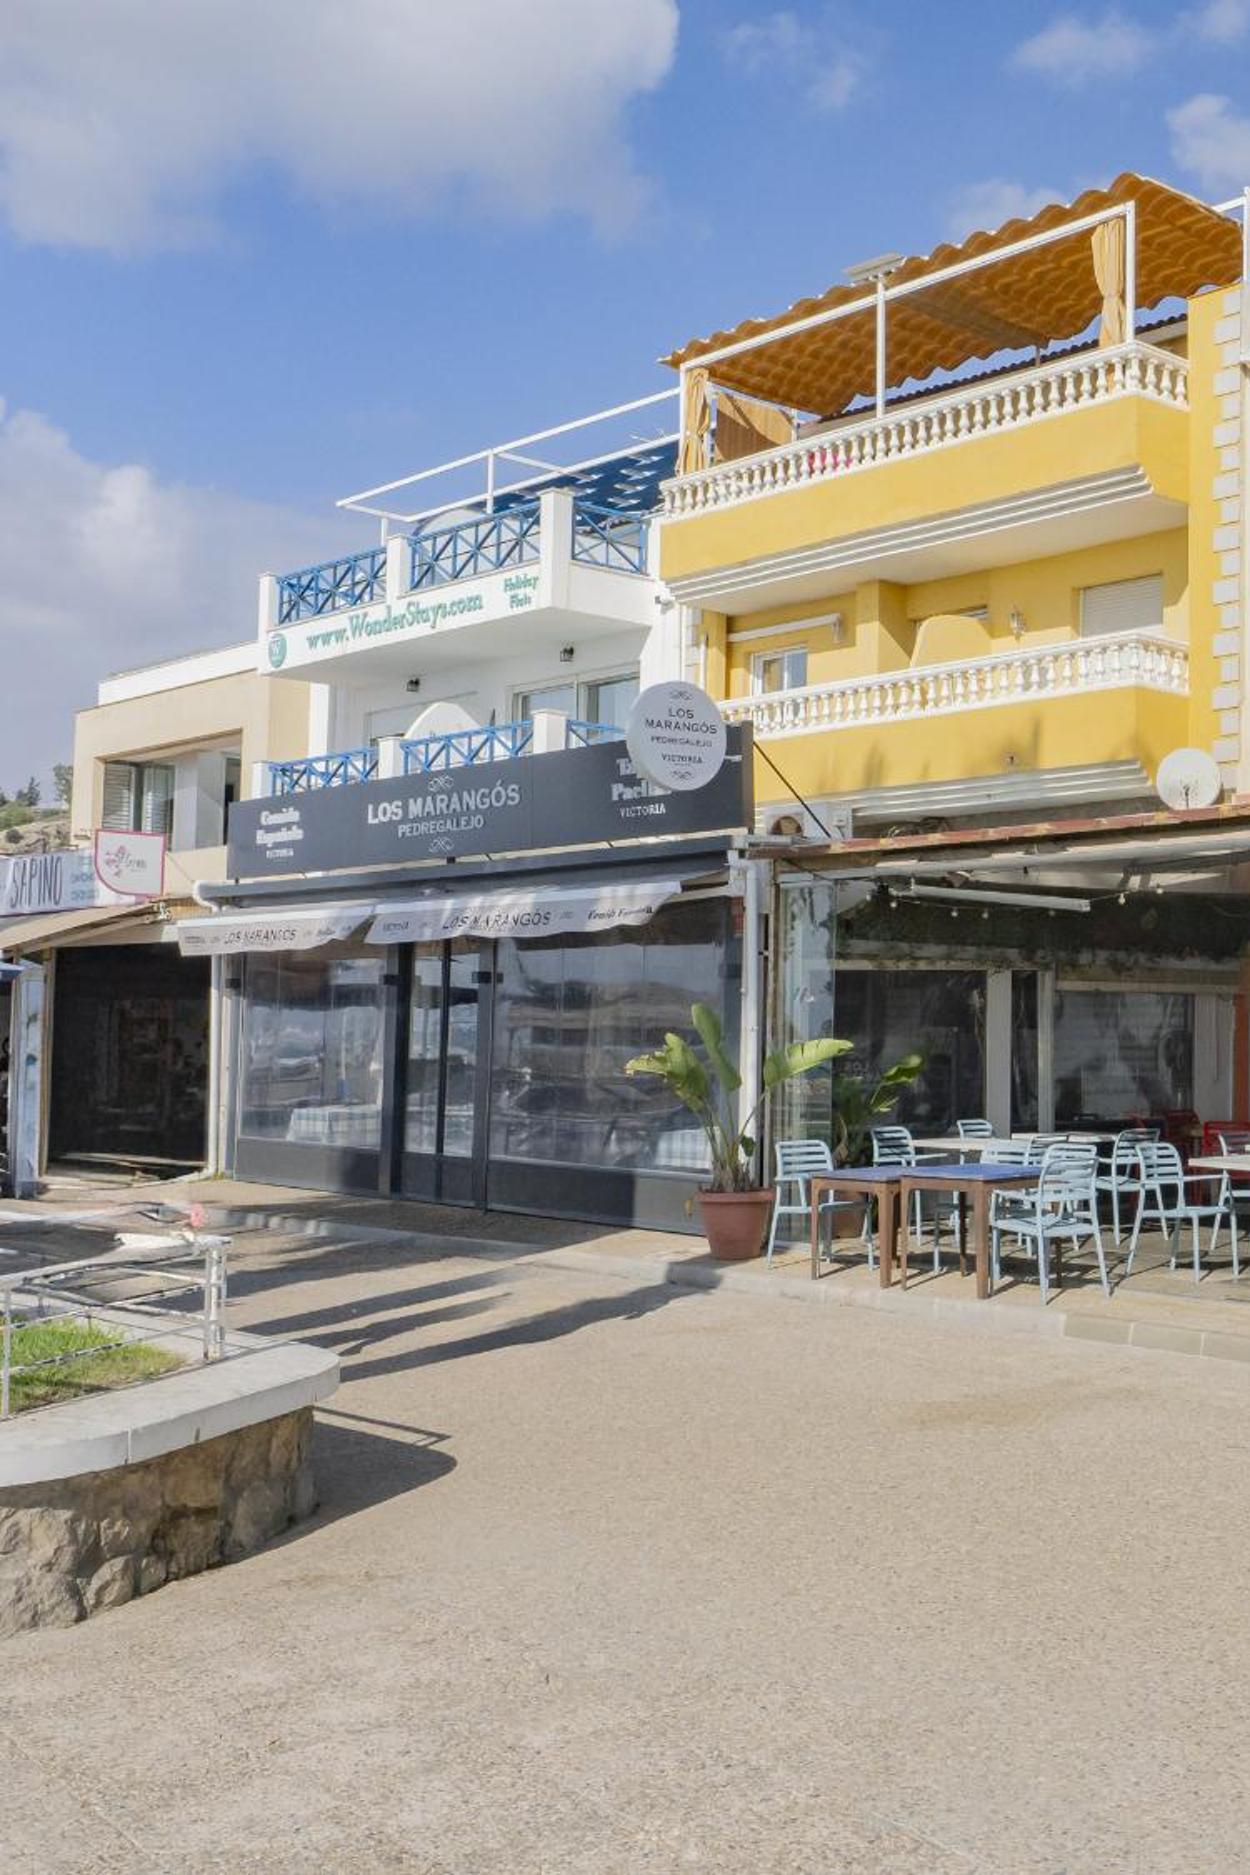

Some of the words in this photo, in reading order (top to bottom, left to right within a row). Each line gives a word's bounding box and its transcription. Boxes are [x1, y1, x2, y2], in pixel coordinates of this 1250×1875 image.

[306, 592, 483, 650] www.WonderStays.com
[668, 707, 694, 719] LOS
[645, 719, 718, 734] MARANGÓS
[650, 736, 712, 748] PEDREGALEJO
[661, 752, 703, 764] VICTORIA
[367, 802, 402, 825] LOS
[407, 780, 521, 820] MARANGÓS
[620, 803, 667, 818] VICTORIA
[398, 814, 484, 839] PEDREGALEJO
